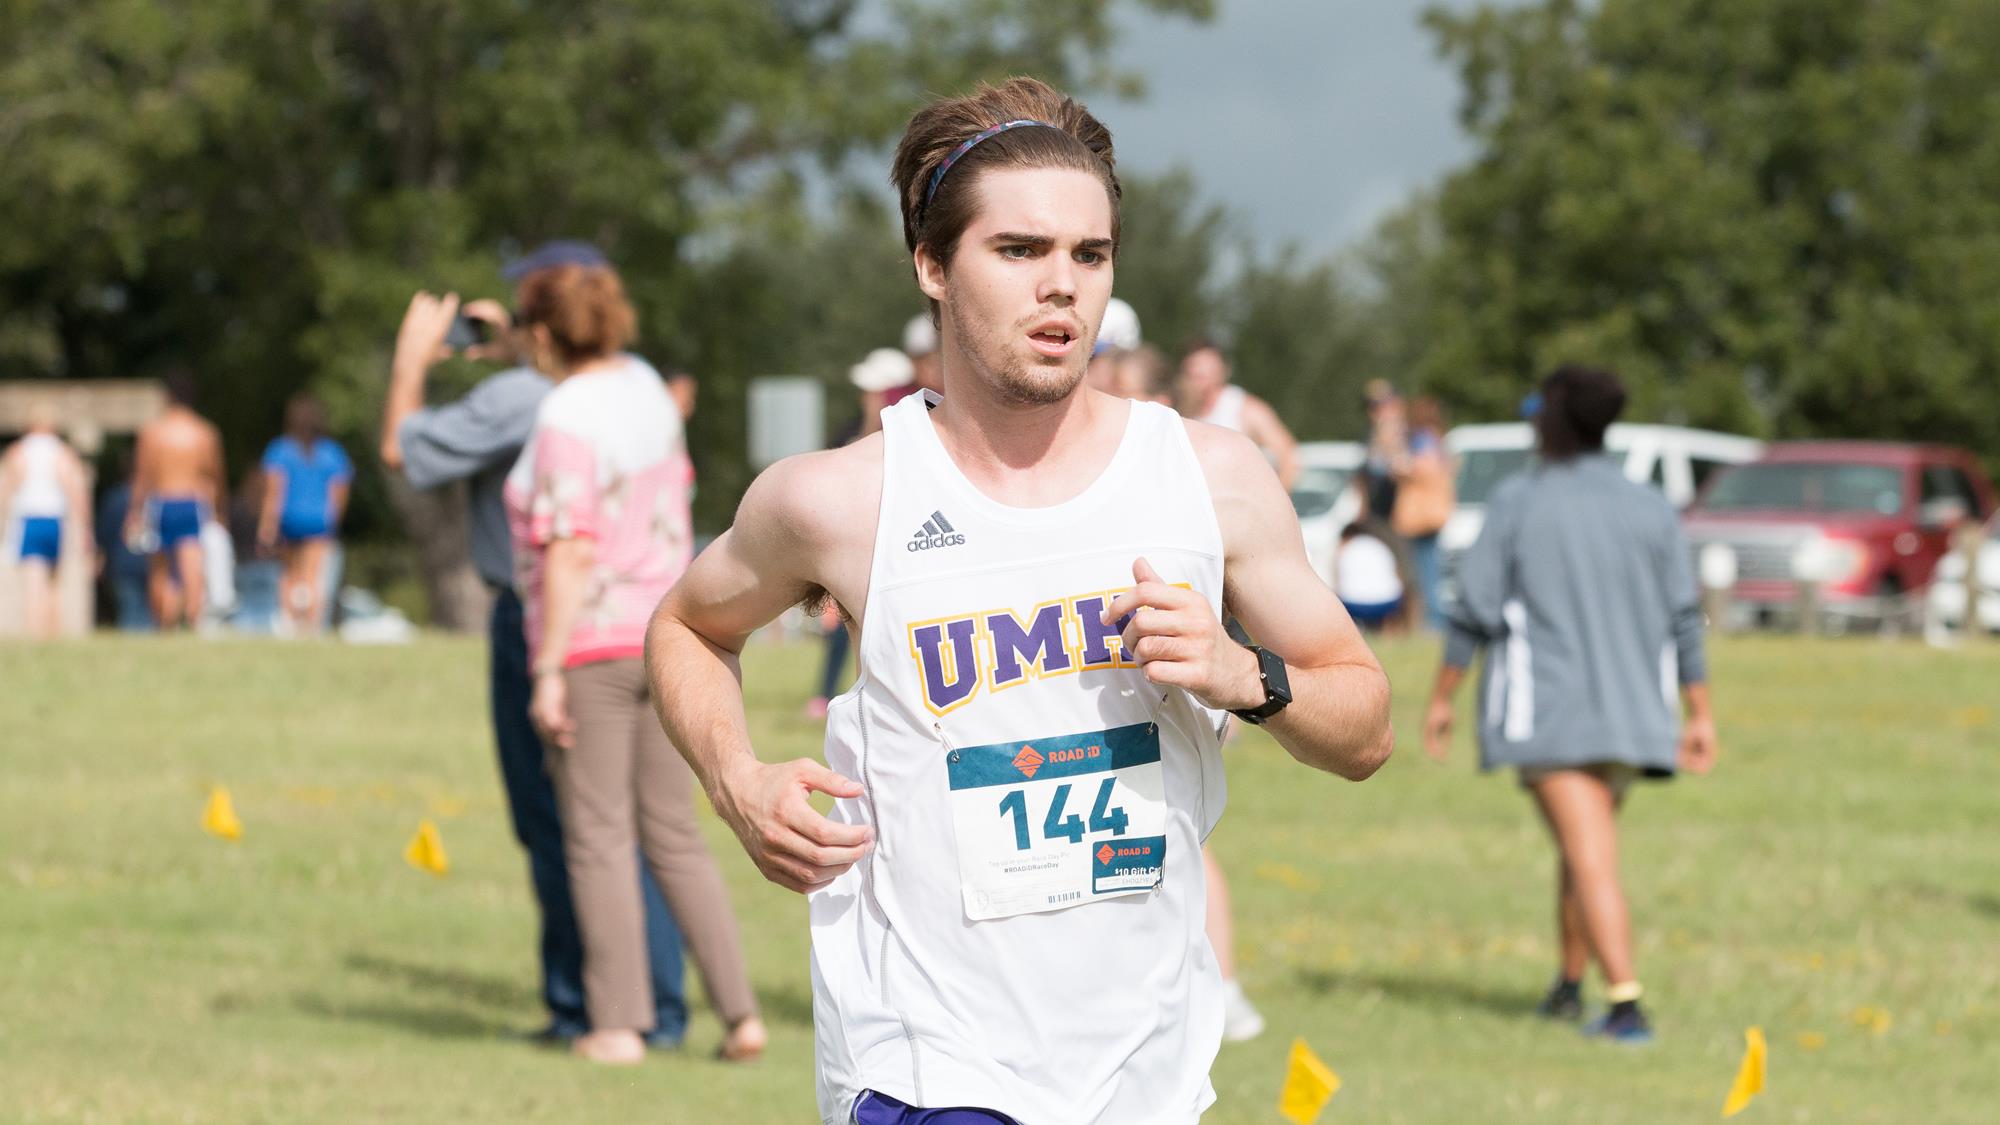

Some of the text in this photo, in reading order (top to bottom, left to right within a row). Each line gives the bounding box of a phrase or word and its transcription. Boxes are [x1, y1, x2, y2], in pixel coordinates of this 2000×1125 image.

[907, 533, 966, 552] adidas
[907, 583, 1192, 718] UMH
[1048, 748, 1085, 763] ROAD
[999, 776, 1129, 851] 144
[1117, 847, 1141, 857] ROAD
[1004, 862, 1059, 873] #ROADiDRaceDay
[1115, 867, 1129, 876] $10
[1131, 867, 1147, 875] Gift
